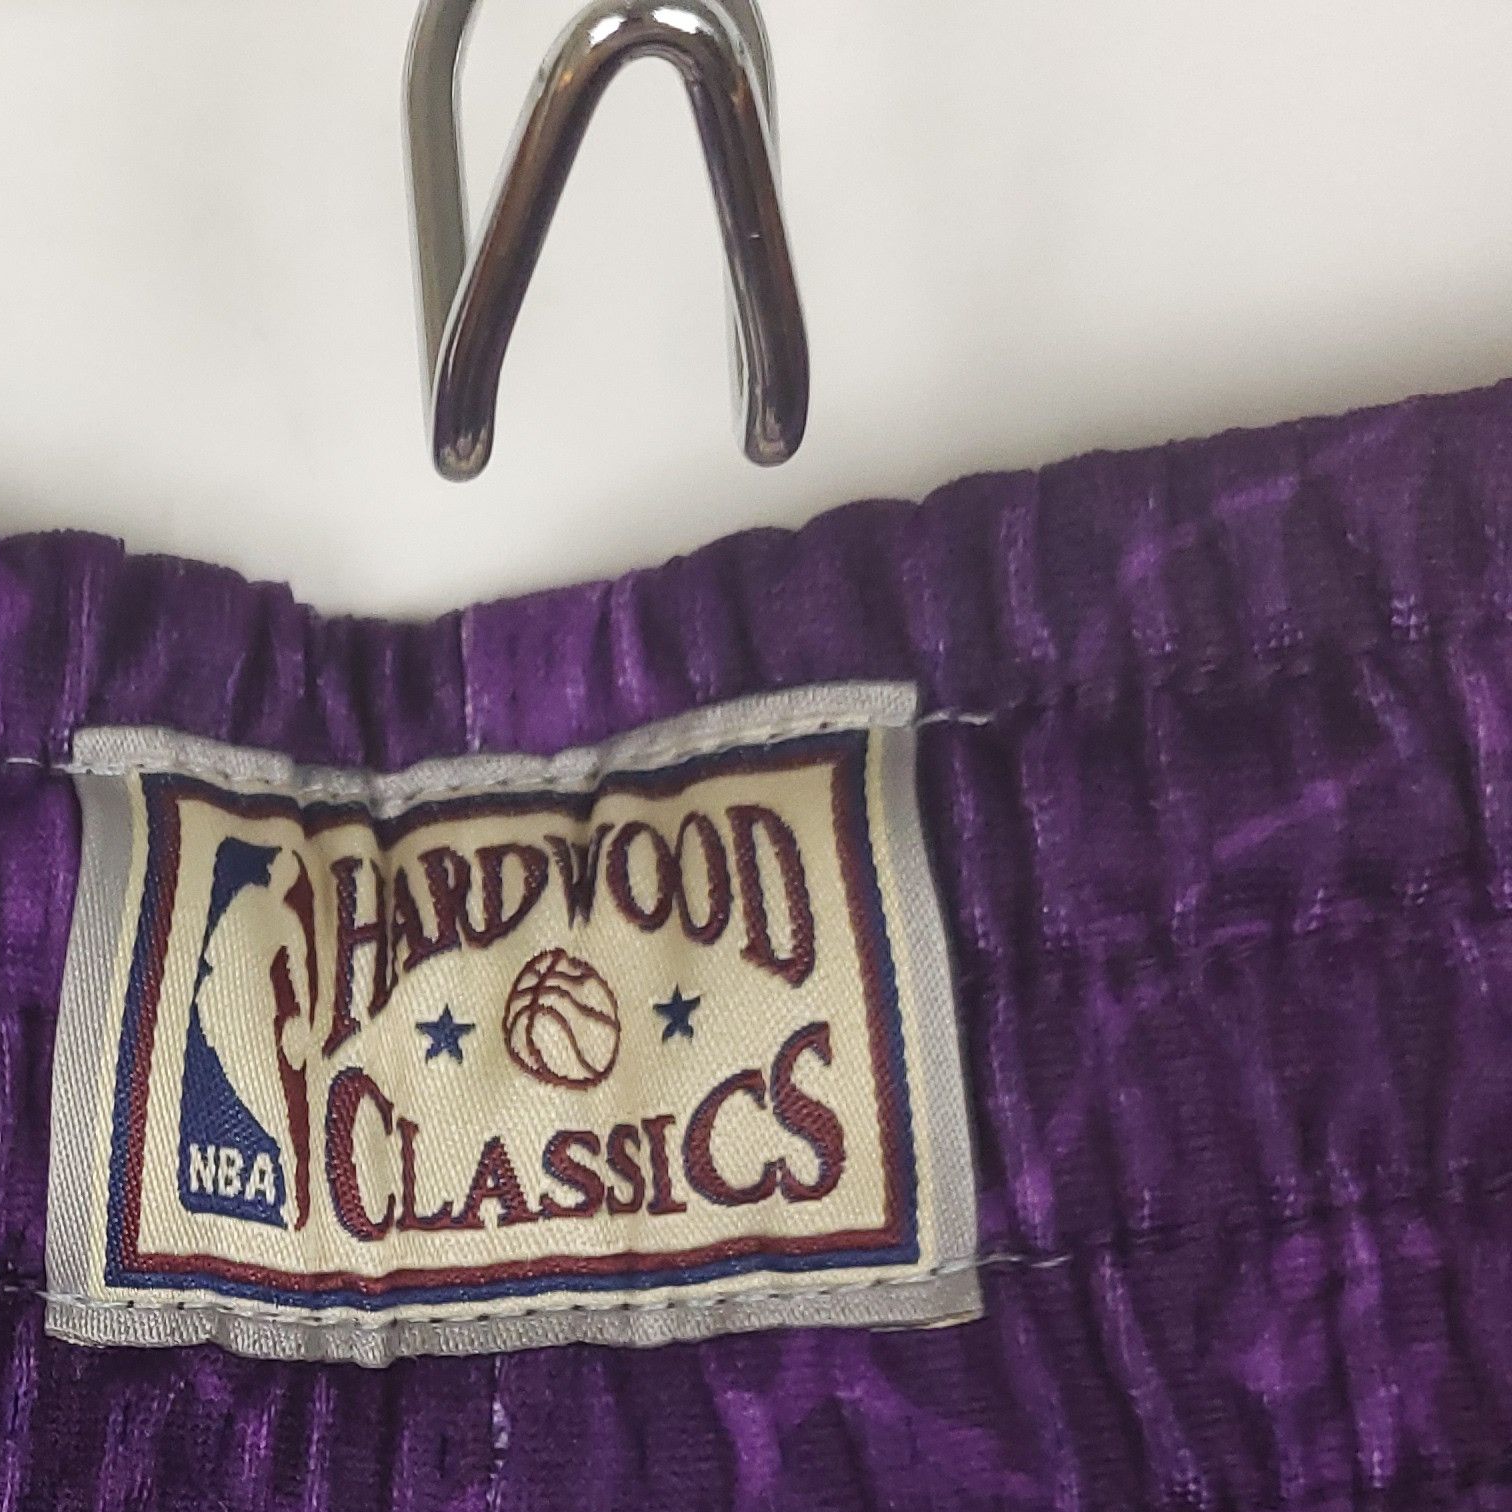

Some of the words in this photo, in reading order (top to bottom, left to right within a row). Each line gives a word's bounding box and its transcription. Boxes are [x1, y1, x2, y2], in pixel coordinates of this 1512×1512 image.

[322, 804, 816, 1057] HARDWOOD
[188, 1141, 280, 1201] NBA
[324, 1021, 846, 1243] CLASSICS
